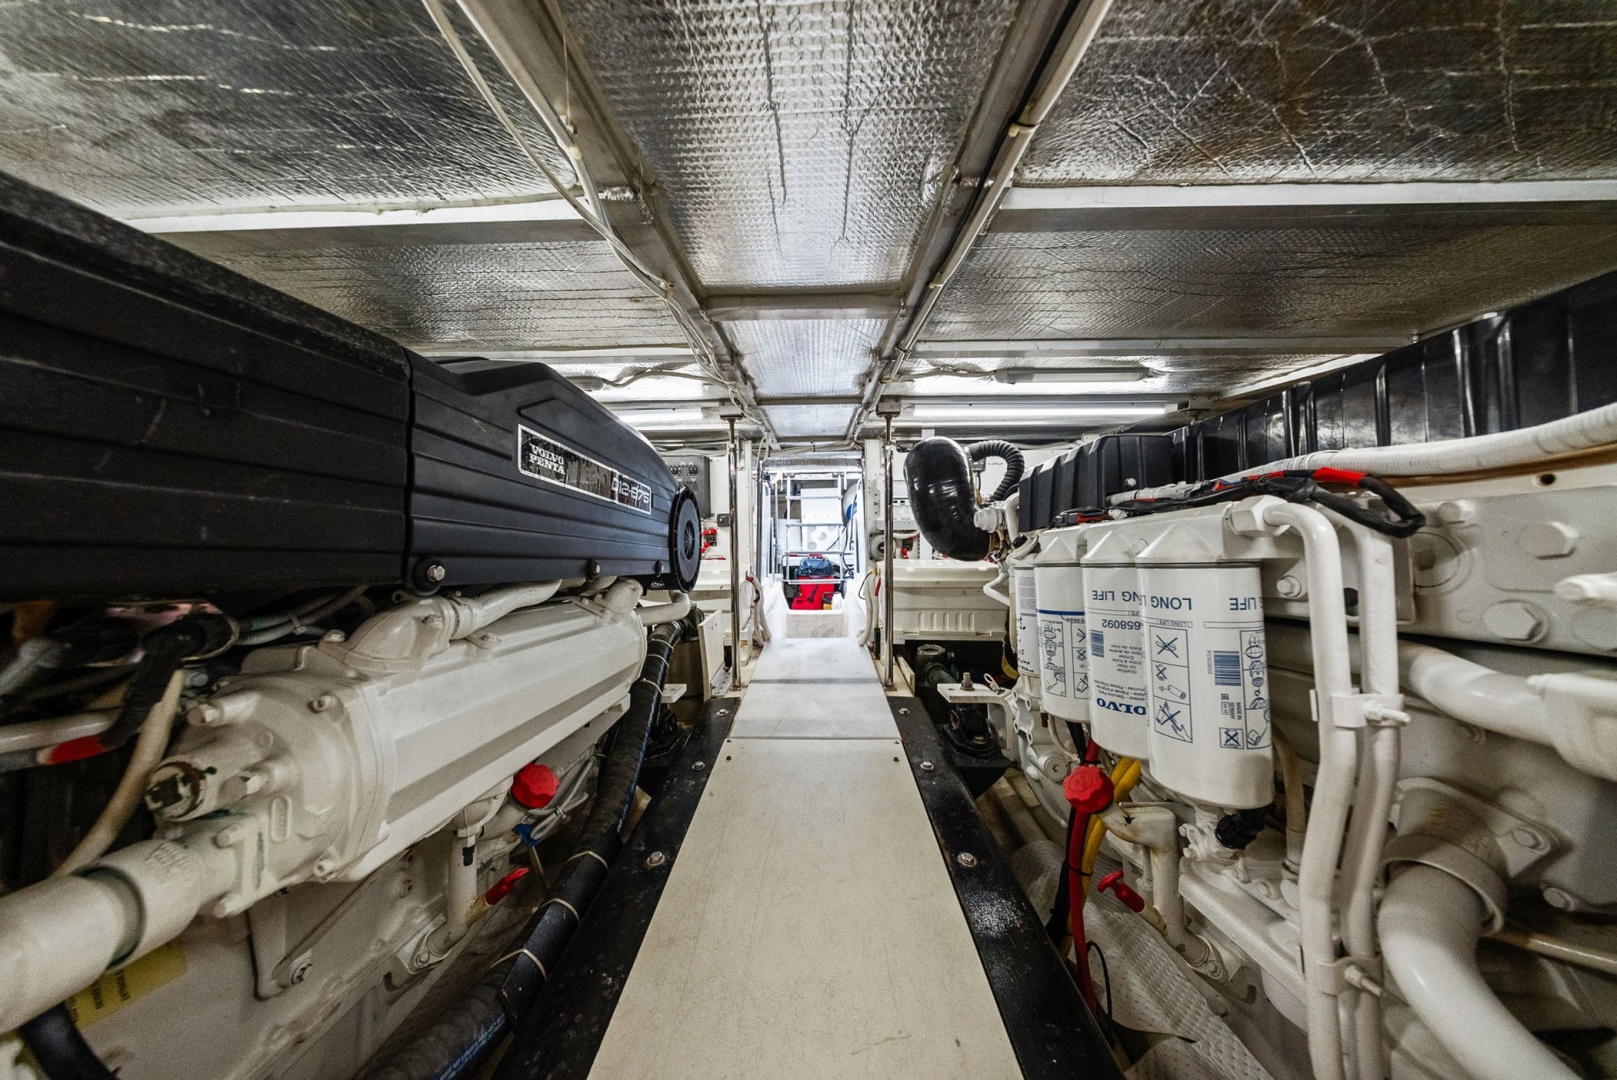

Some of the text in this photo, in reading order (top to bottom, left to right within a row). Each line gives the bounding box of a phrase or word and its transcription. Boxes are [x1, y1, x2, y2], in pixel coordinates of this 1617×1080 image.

[529, 443, 564, 465] VOLVO
[529, 453, 566, 475] PENTA
[1092, 590, 1115, 601] LIFE
[1151, 596, 1192, 610] LONG
[1229, 597, 1257, 611] LIFE
[1102, 619, 1142, 631] 658092
[1097, 698, 1146, 716] OLVO
